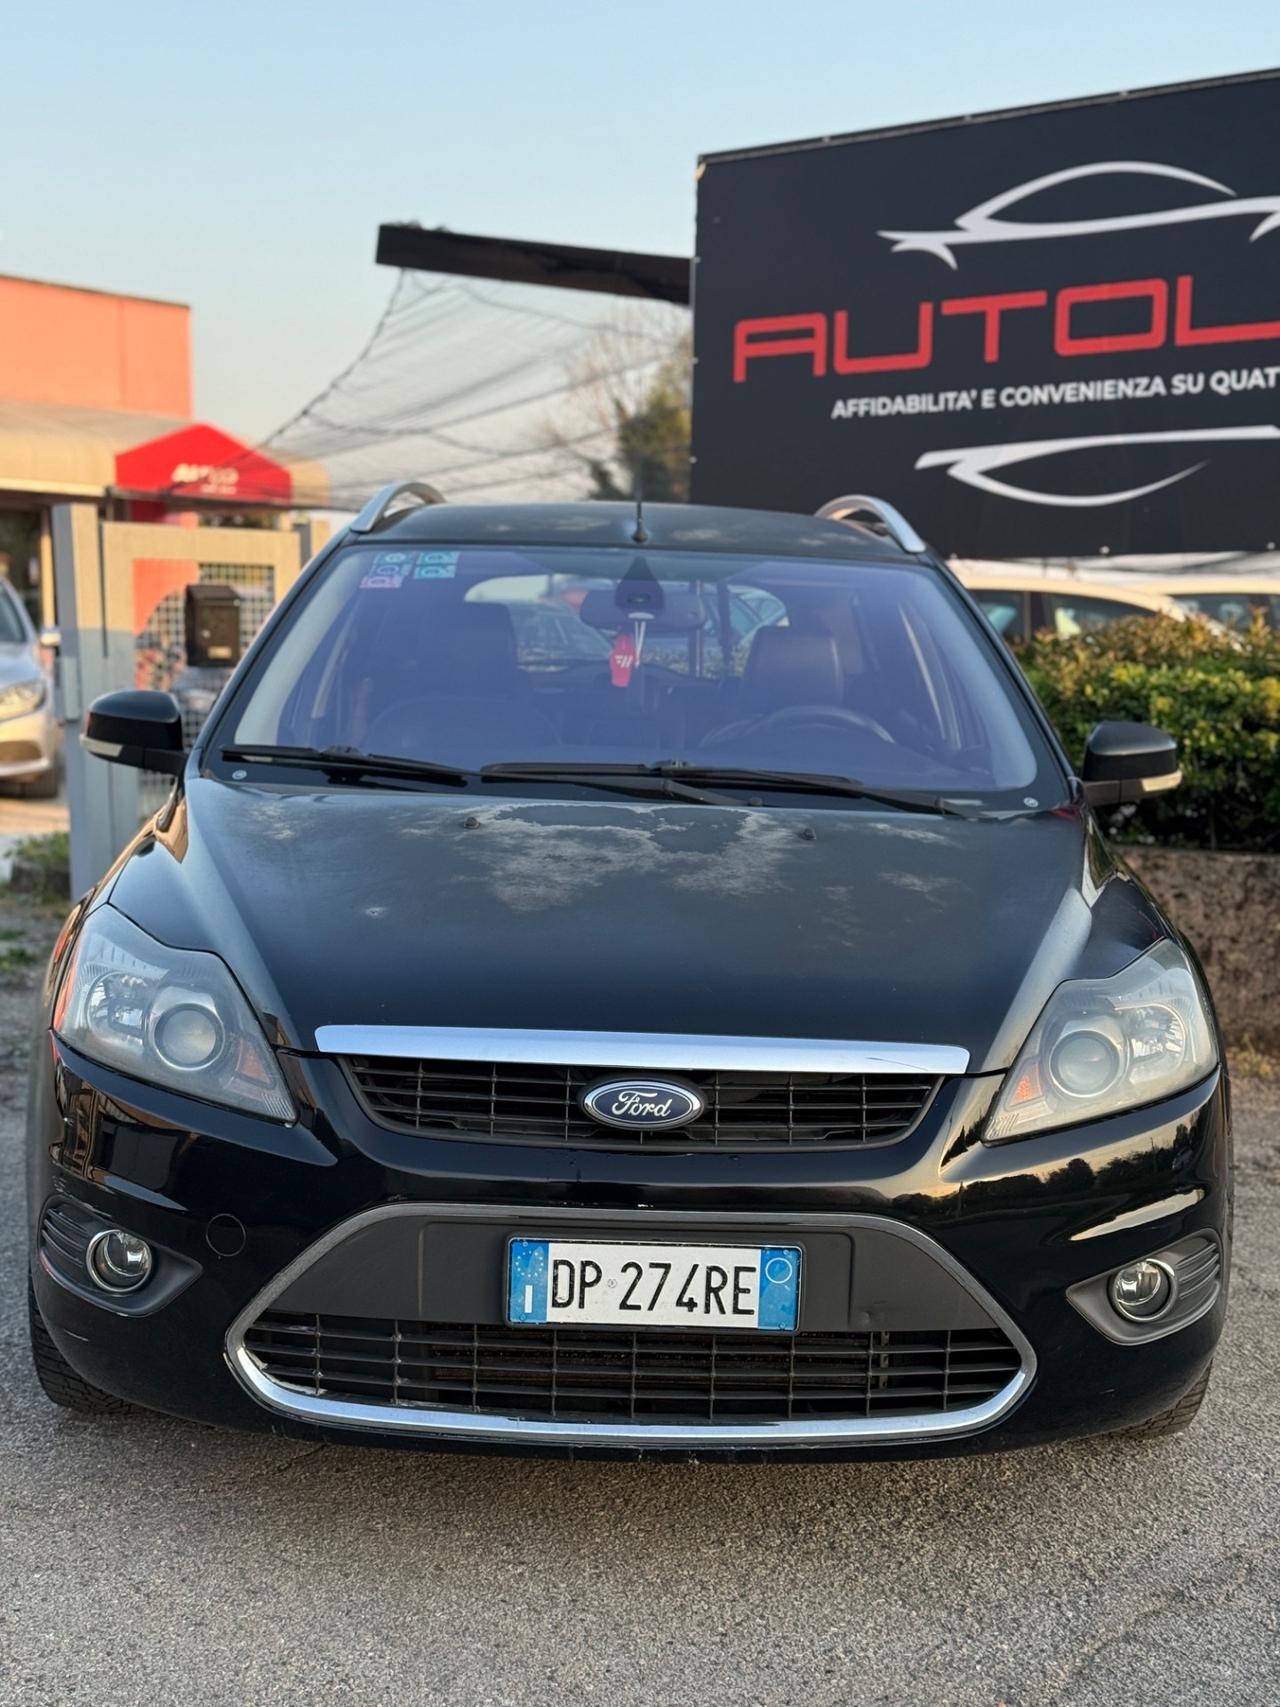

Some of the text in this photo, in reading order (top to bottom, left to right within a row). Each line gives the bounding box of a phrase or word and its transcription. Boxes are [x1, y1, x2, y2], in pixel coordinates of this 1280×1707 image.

[733, 274, 1280, 383] AUTOL
[981, 388, 996, 409] E
[1000, 375, 1167, 407] CONVENIENZA
[1171, 372, 1205, 395] SU
[611, 1090, 673, 1117] Ford
